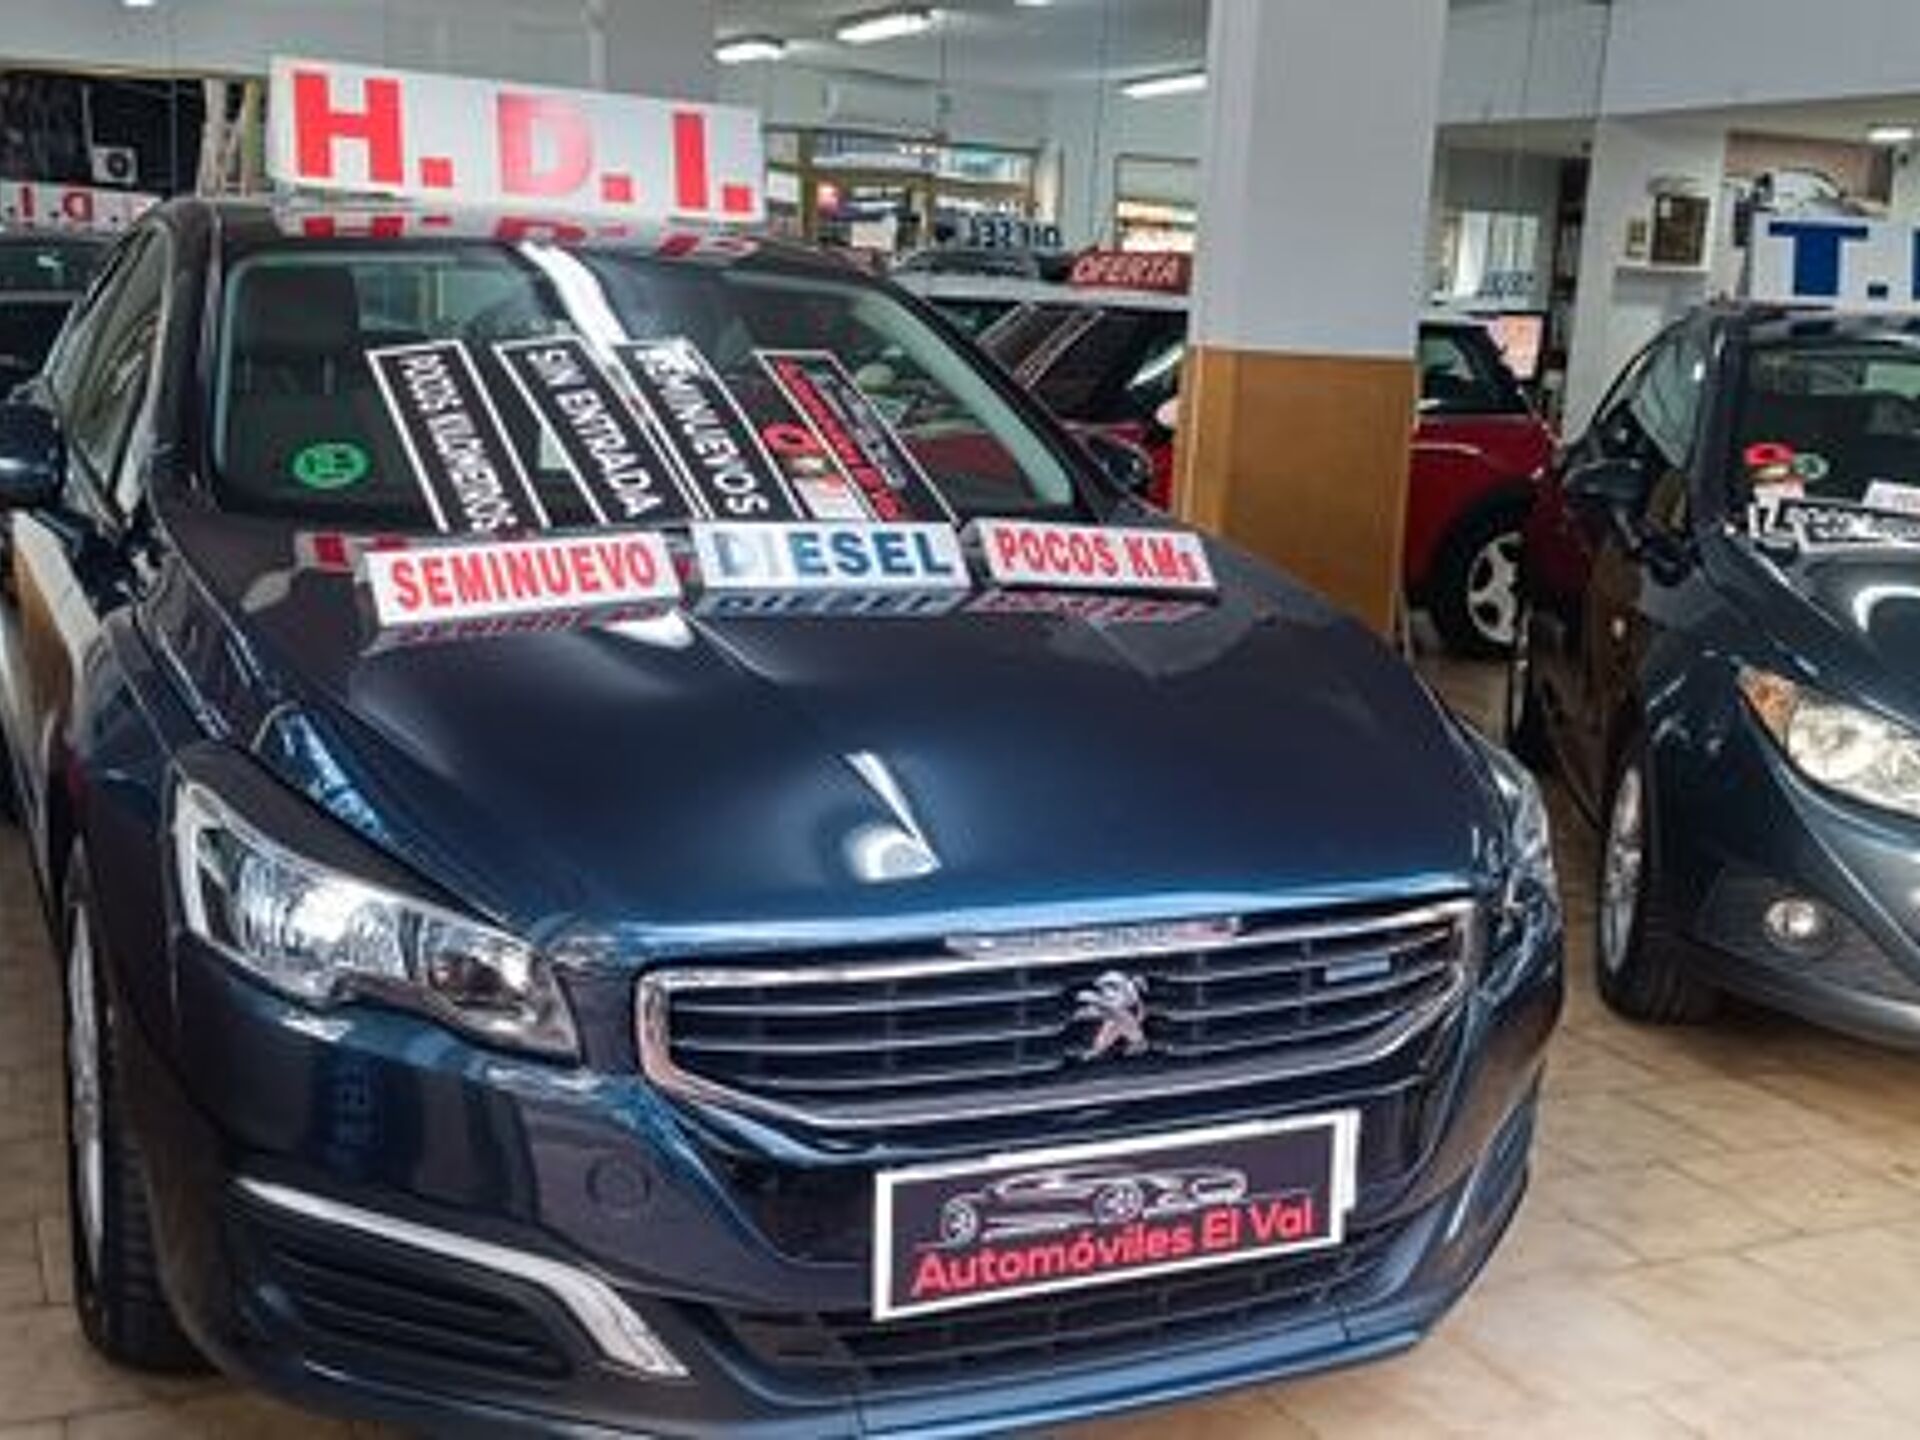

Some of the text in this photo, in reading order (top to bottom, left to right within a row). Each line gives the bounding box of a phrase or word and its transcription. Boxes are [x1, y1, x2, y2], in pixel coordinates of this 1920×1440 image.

[1071, 254, 1180, 287] OFERTA
[526, 349, 663, 518] SIN ENTRADA
[634, 348, 769, 515] SEMINUEVOS
[389, 542, 657, 612] SEMINUEVO
[714, 530, 955, 580] DIESEL
[995, 526, 1119, 578] POCOS
[911, 1195, 1313, 1298] Automóviles El Val
